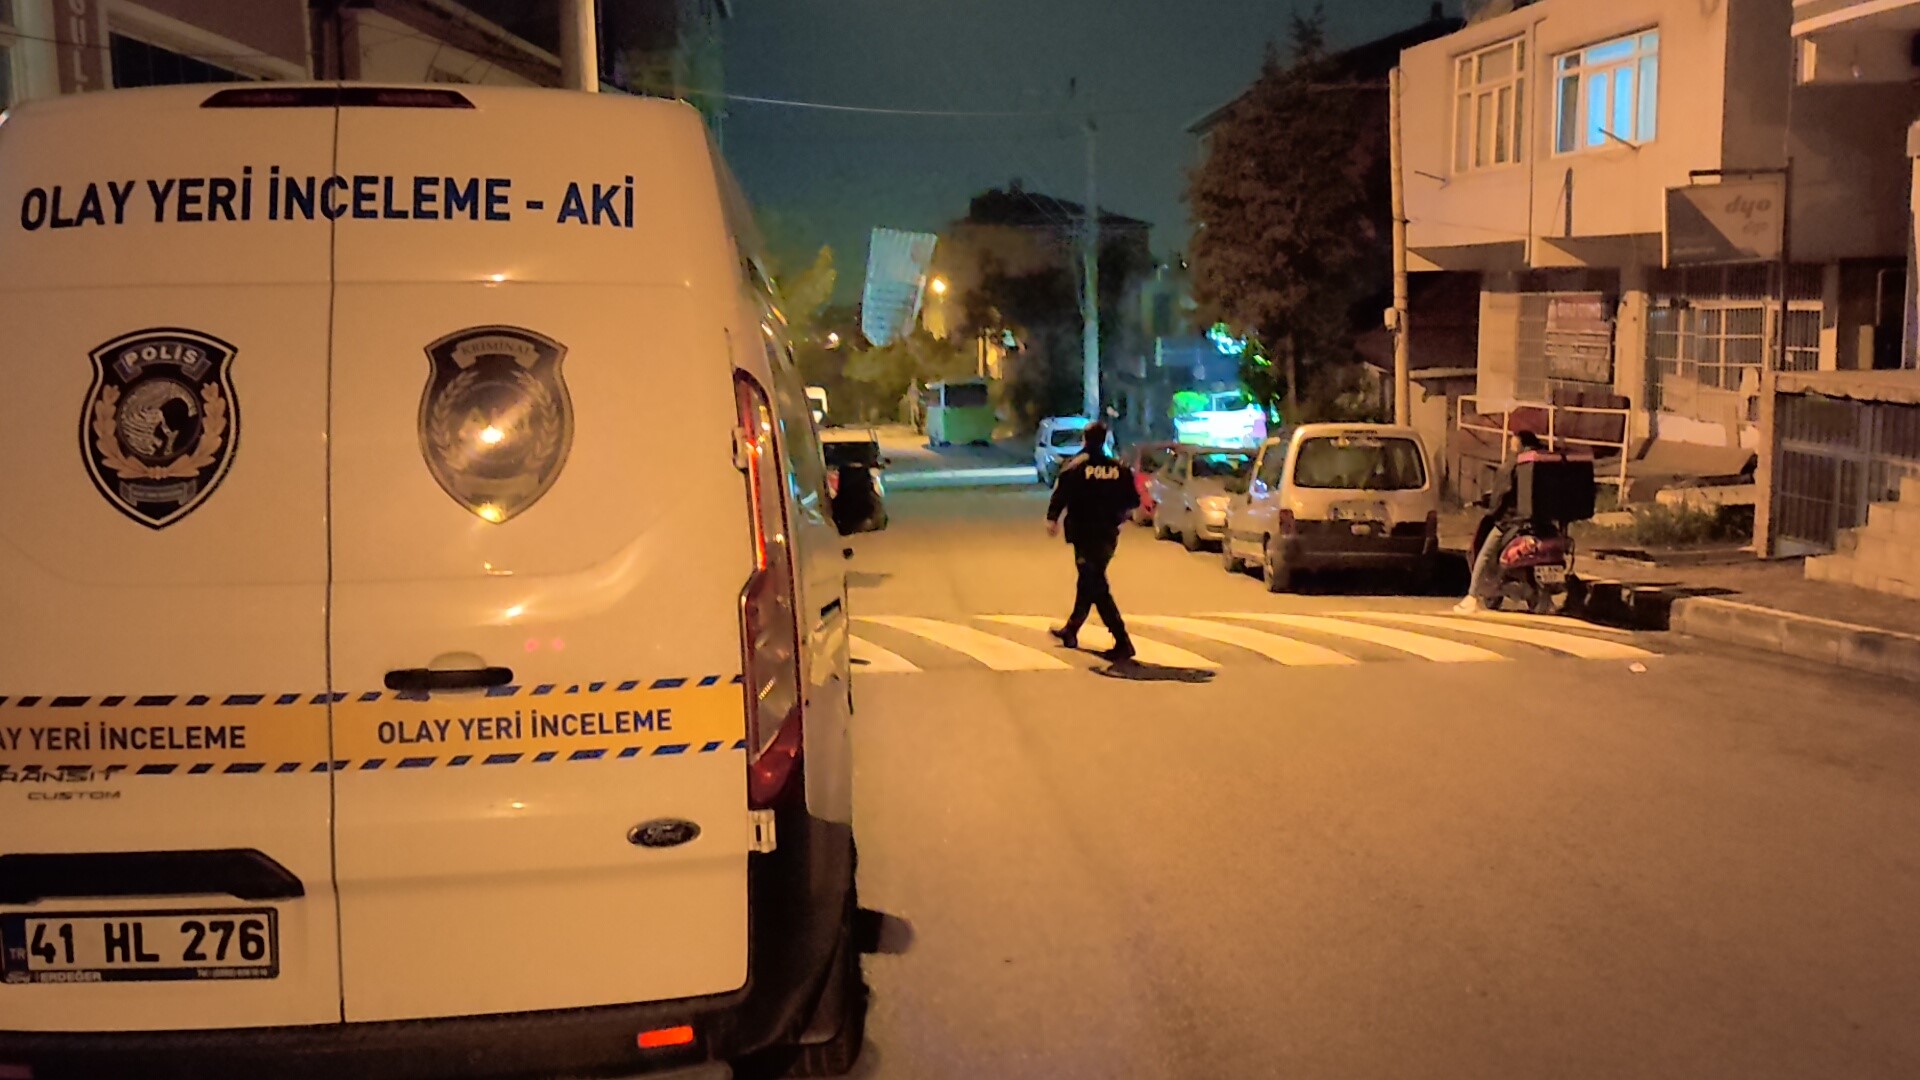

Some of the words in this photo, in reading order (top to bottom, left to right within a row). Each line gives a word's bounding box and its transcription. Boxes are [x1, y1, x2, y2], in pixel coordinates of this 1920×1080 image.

[19, 180, 135, 230] OLAY
[148, 166, 253, 222] YERİ
[268, 165, 512, 221] İNCELEME
[525, 202, 545, 210] -
[556, 175, 636, 228] AKİ
[29, 721, 91, 751] YERİ
[100, 720, 247, 751] İNCELEME
[377, 718, 451, 745] OLAY
[458, 710, 523, 742] YERİ
[531, 708, 673, 740] İNCELEME
[27, 790, 122, 801] CUSTOM
[31, 922, 75, 964] 41
[104, 922, 160, 963] HL
[180, 919, 266, 961] 276
